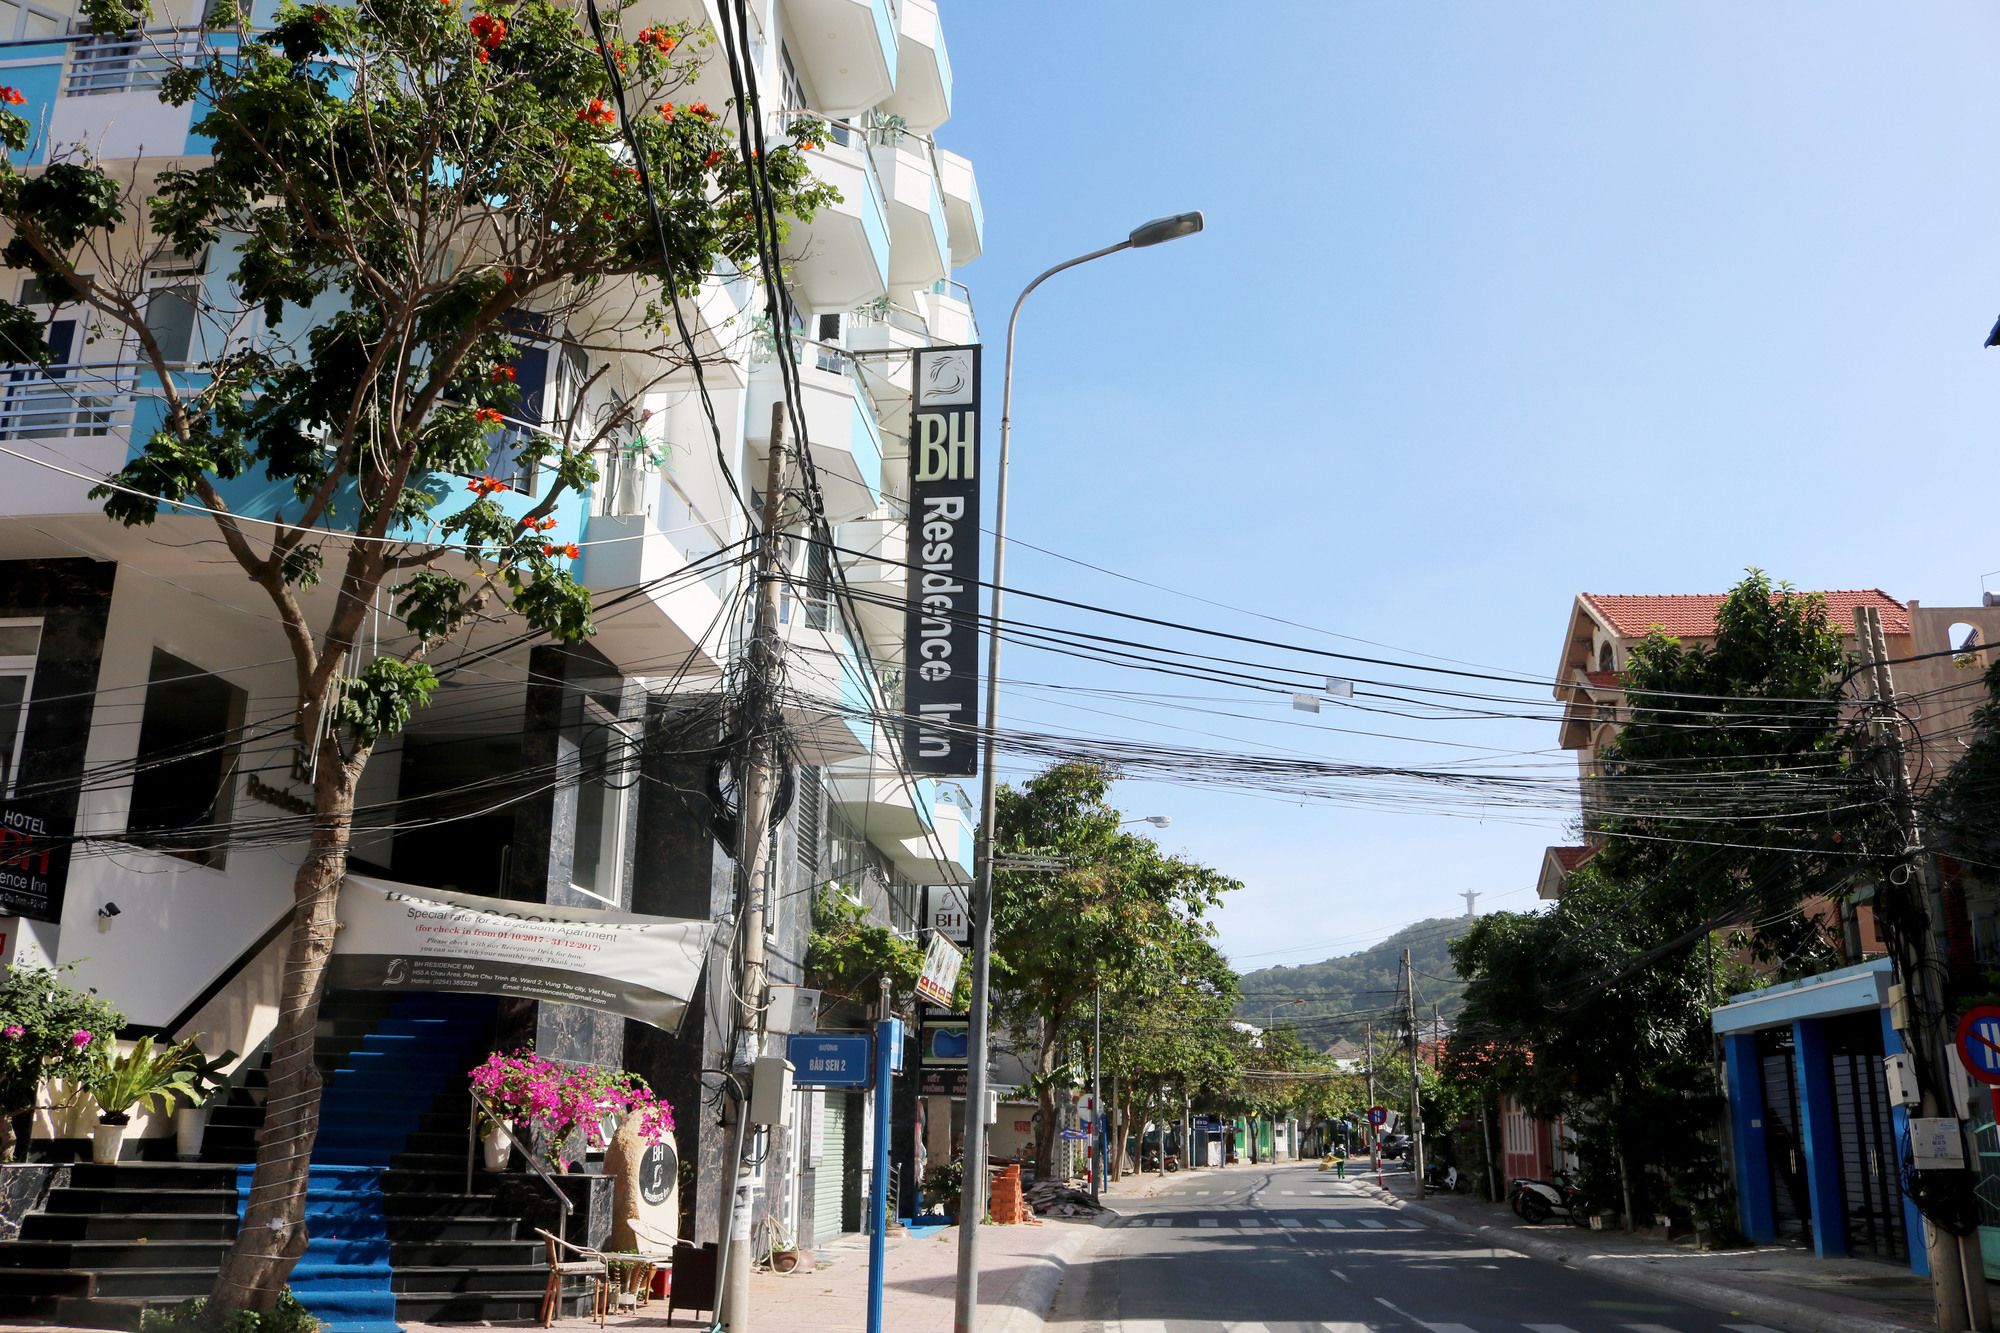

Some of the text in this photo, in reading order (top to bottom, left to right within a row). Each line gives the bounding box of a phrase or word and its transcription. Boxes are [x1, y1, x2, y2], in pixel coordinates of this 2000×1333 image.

[915, 409, 974, 482] BH
[918, 495, 964, 759] Residence Inn
[4, 809, 46, 835] HOTEL
[31, 875, 47, 893] Inn
[407, 907, 447, 920] Special
[450, 913, 471, 922] rate
[558, 927, 617, 942] Apartment
[936, 913, 960, 927] BH
[415, 924, 432, 932] (for
[433, 925, 459, 934] check
[473, 928, 497, 938] from
[497, 931, 544, 943] 01/10/2017
[550, 937, 601, 952] 31/12/2017)
[426, 937, 448, 945] Please
[497, 951, 525, 960] monthly
[424, 961, 462, 969] RESIDENCE
[494, 974, 510, 982] Trinh
[520, 977, 537, 985] Ward
[545, 980, 561, 989] Vung
[588, 987, 601, 995] Viet
[601, 990, 617, 999] Nam
[825, 1059, 840, 1071] SEN
[841, 1059, 846, 1071] 2
[652, 1144, 664, 1162] BH
